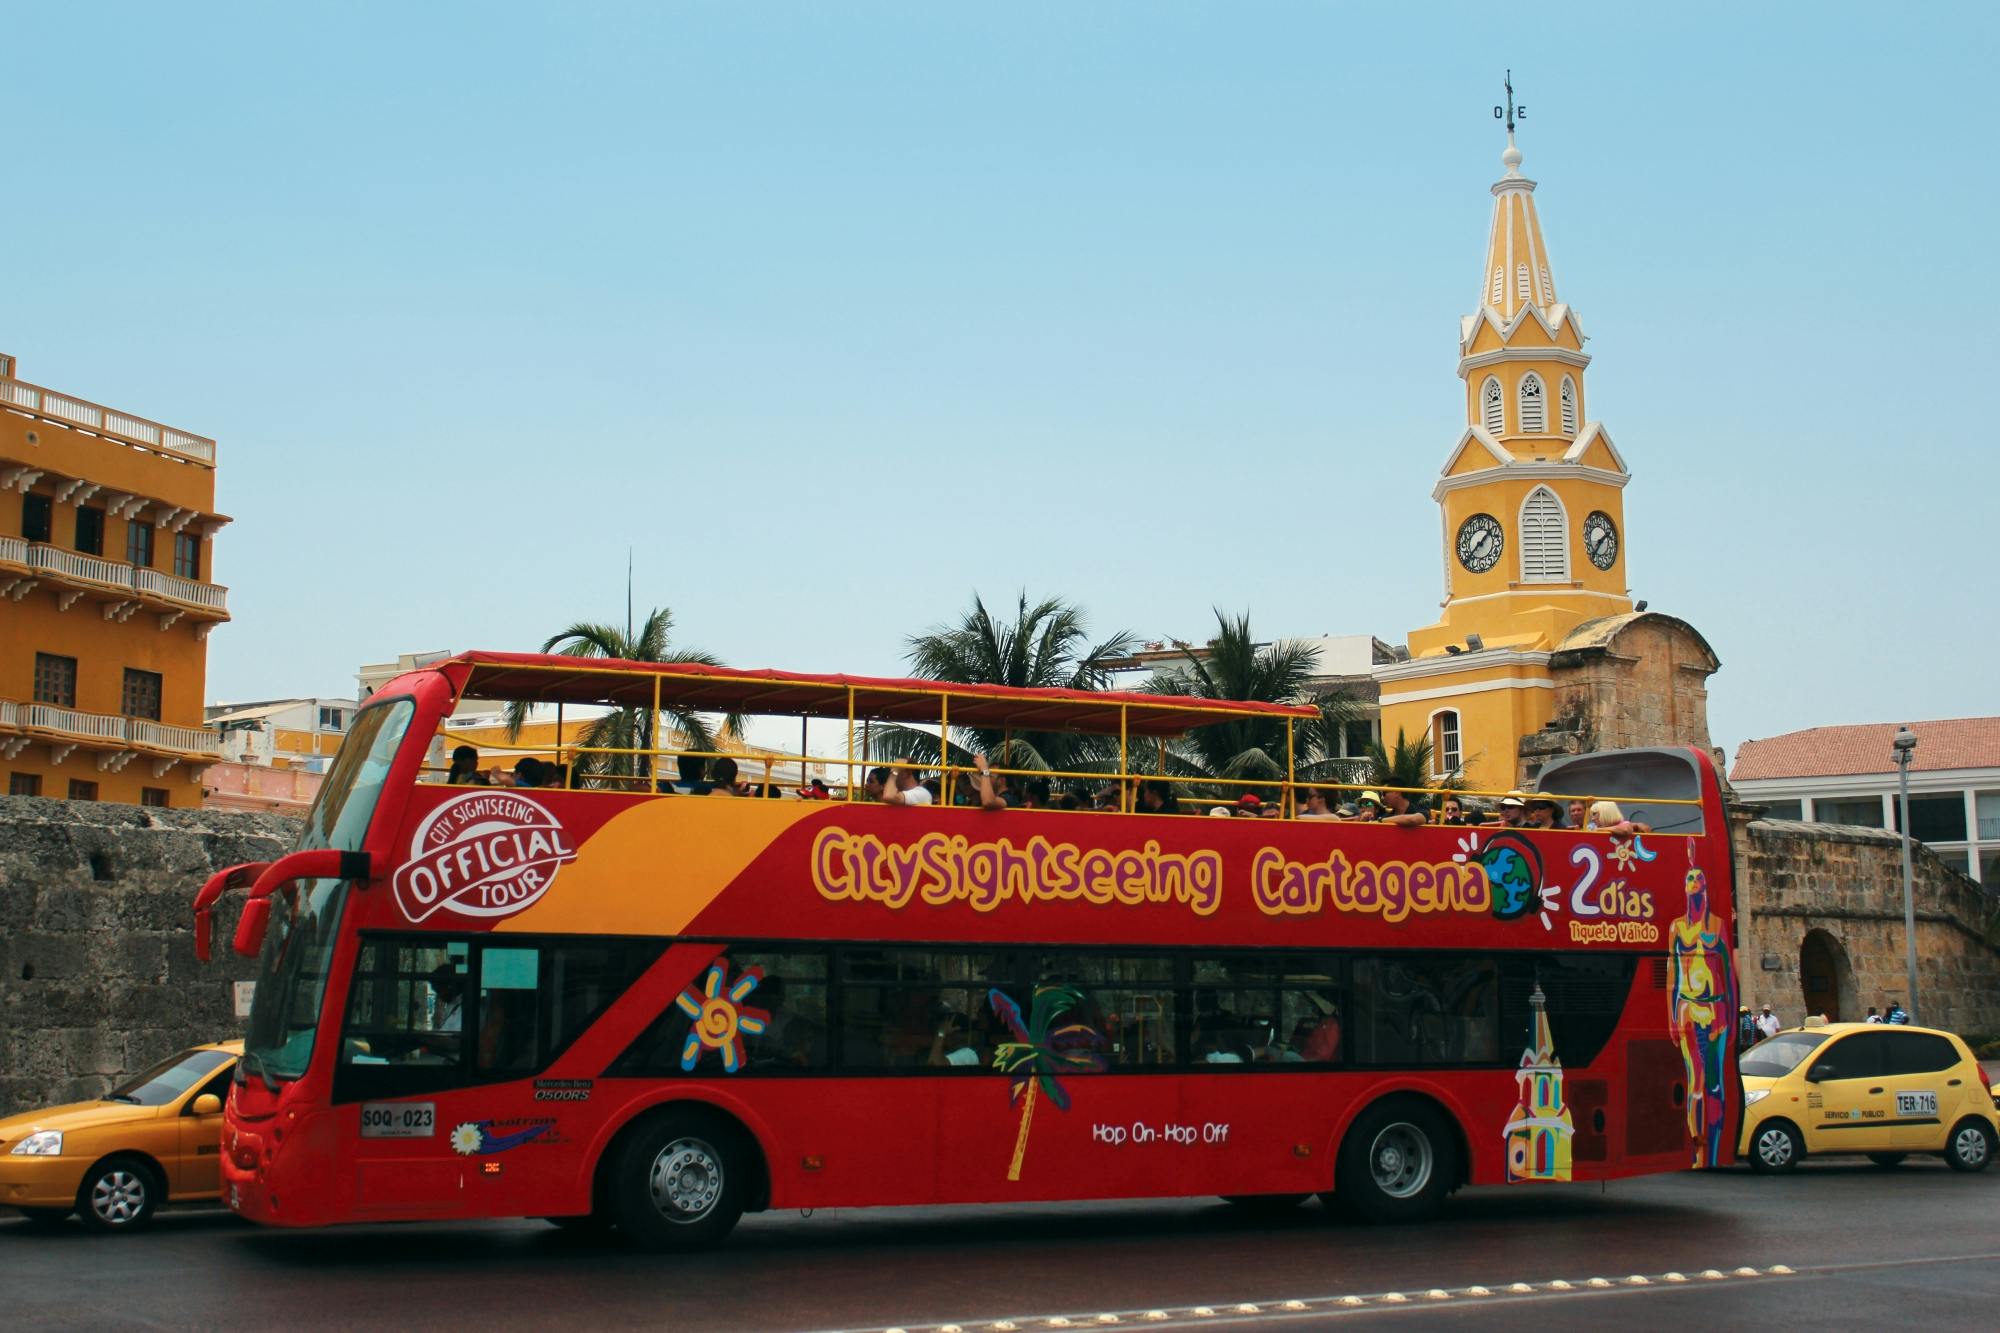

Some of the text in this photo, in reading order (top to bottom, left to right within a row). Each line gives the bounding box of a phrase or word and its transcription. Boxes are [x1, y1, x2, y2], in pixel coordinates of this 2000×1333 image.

[1518, 106, 1526, 118] E
[429, 799, 533, 844] CITY SIGHTSEEING
[410, 830, 571, 903] OFFICIAL
[1252, 846, 1490, 922] Cartagena
[1571, 847, 1654, 918] 2 días
[479, 868, 544, 906] TOUR
[1569, 920, 1658, 944] Tiquete Válido
[1093, 1123, 1127, 1145] Hop
[1203, 1122, 1230, 1143] Off
[1824, 1110, 1849, 1119] SERVICIO
